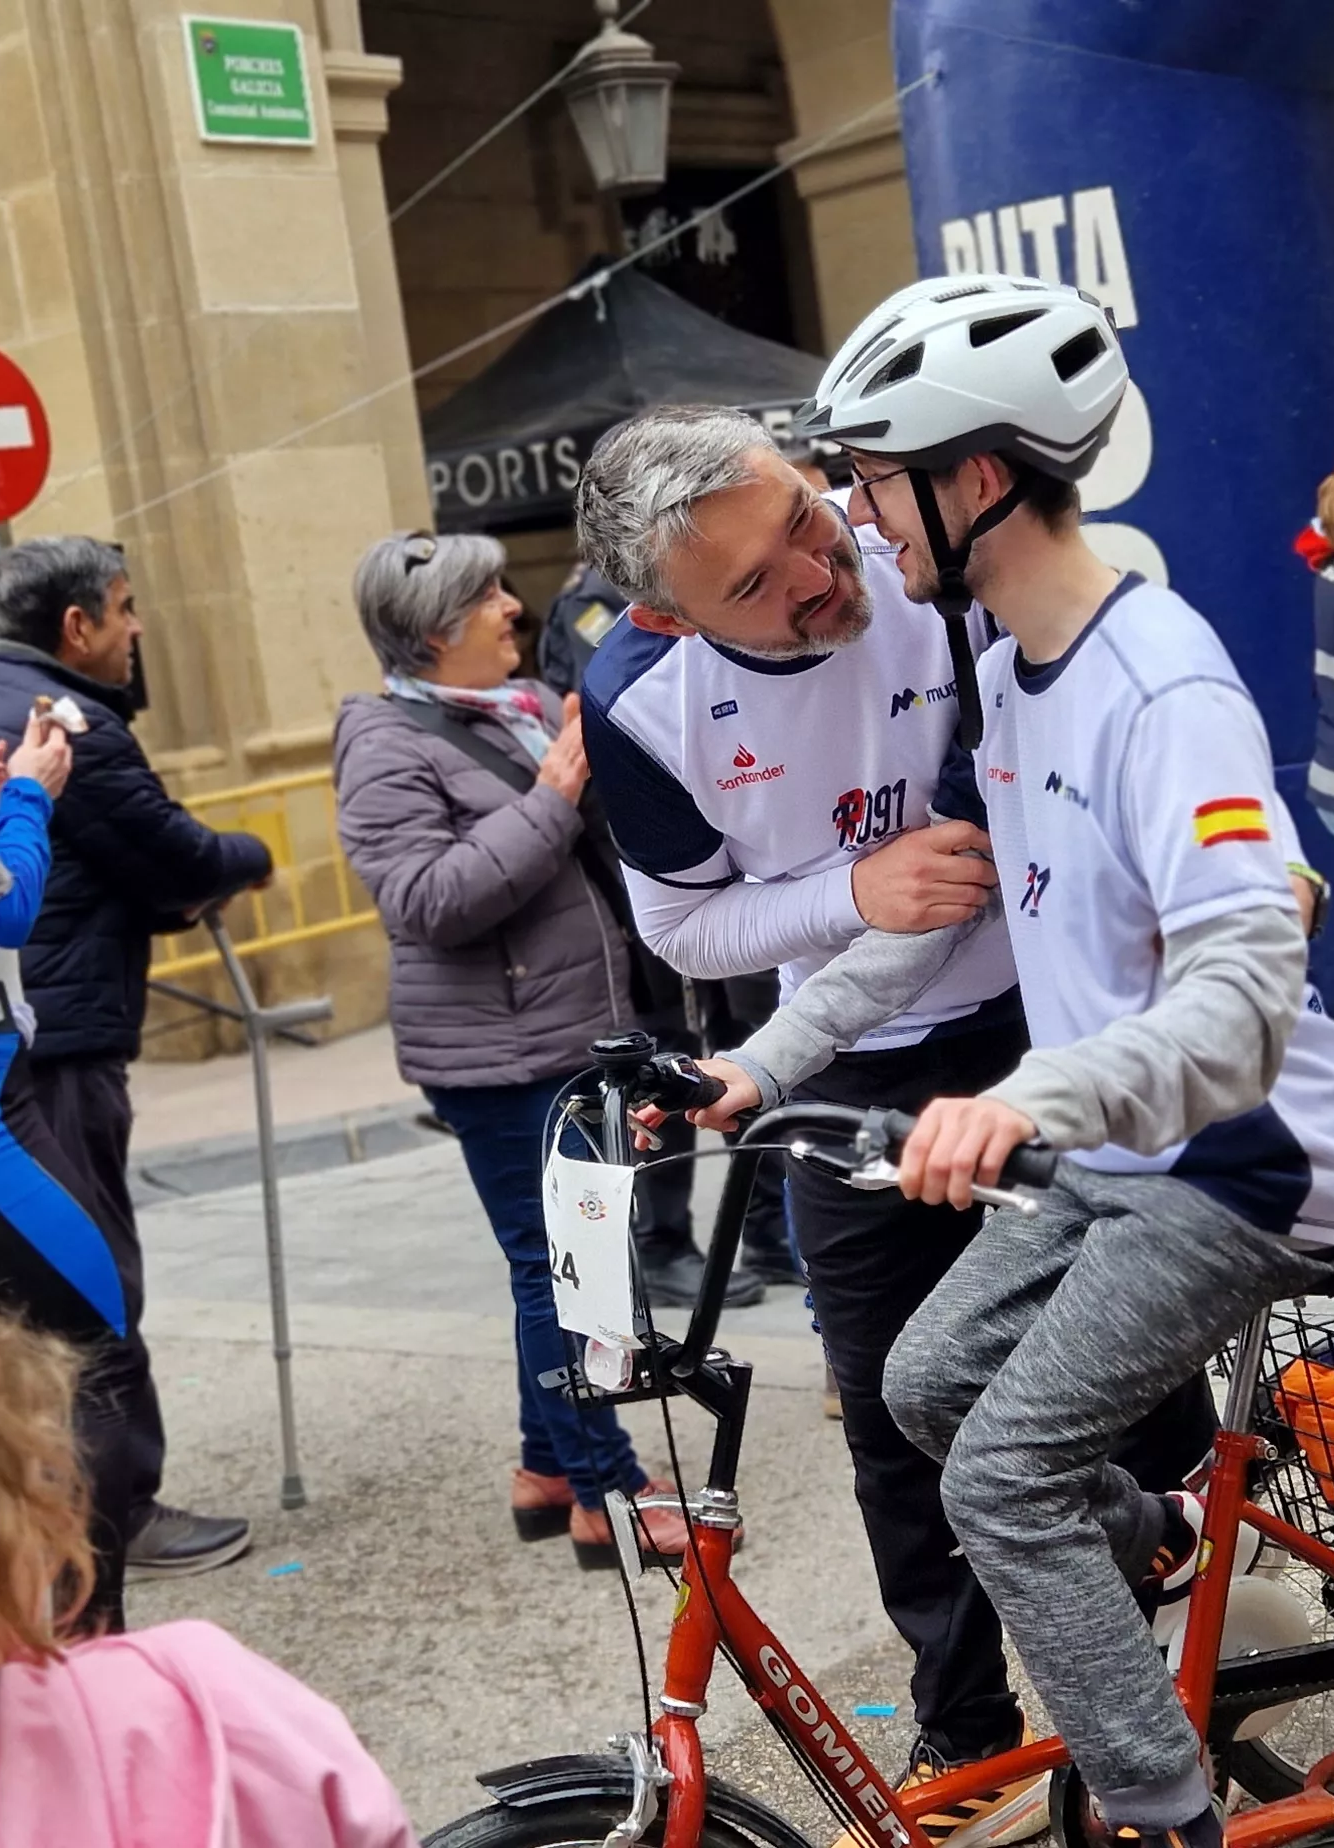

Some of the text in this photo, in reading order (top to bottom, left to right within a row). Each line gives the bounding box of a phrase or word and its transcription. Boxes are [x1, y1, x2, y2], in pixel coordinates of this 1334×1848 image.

[429, 436, 581, 511] PORTS
[925, 680, 958, 704] mup
[716, 764, 785, 791] Santander
[758, 1644, 911, 1848] GOMIER
